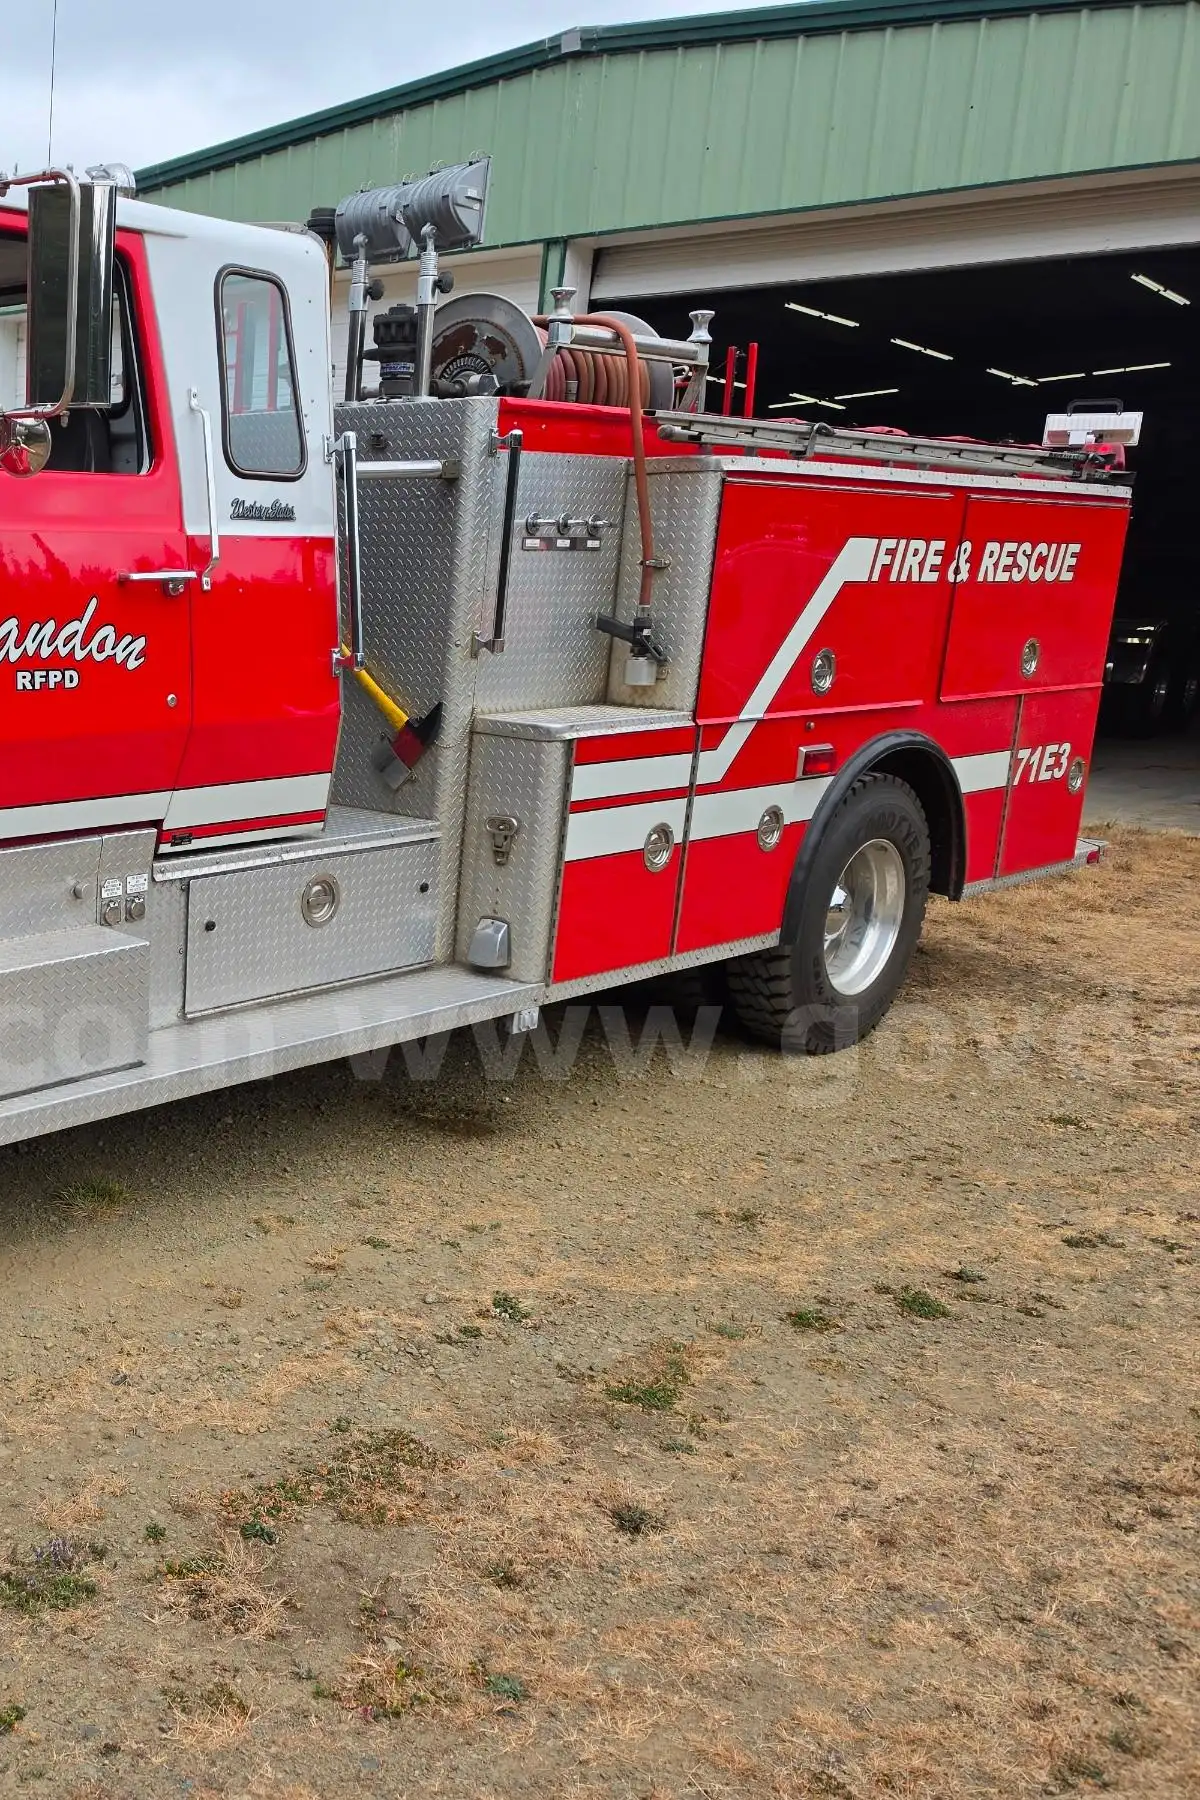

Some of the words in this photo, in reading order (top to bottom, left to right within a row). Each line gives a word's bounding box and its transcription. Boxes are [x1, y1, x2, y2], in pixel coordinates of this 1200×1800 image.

[870, 537, 946, 583] FIRE
[947, 540, 972, 583] &
[976, 541, 1082, 583] RESCUE
[15, 668, 79, 691] RFPD
[1012, 742, 1071, 786] 71E3
